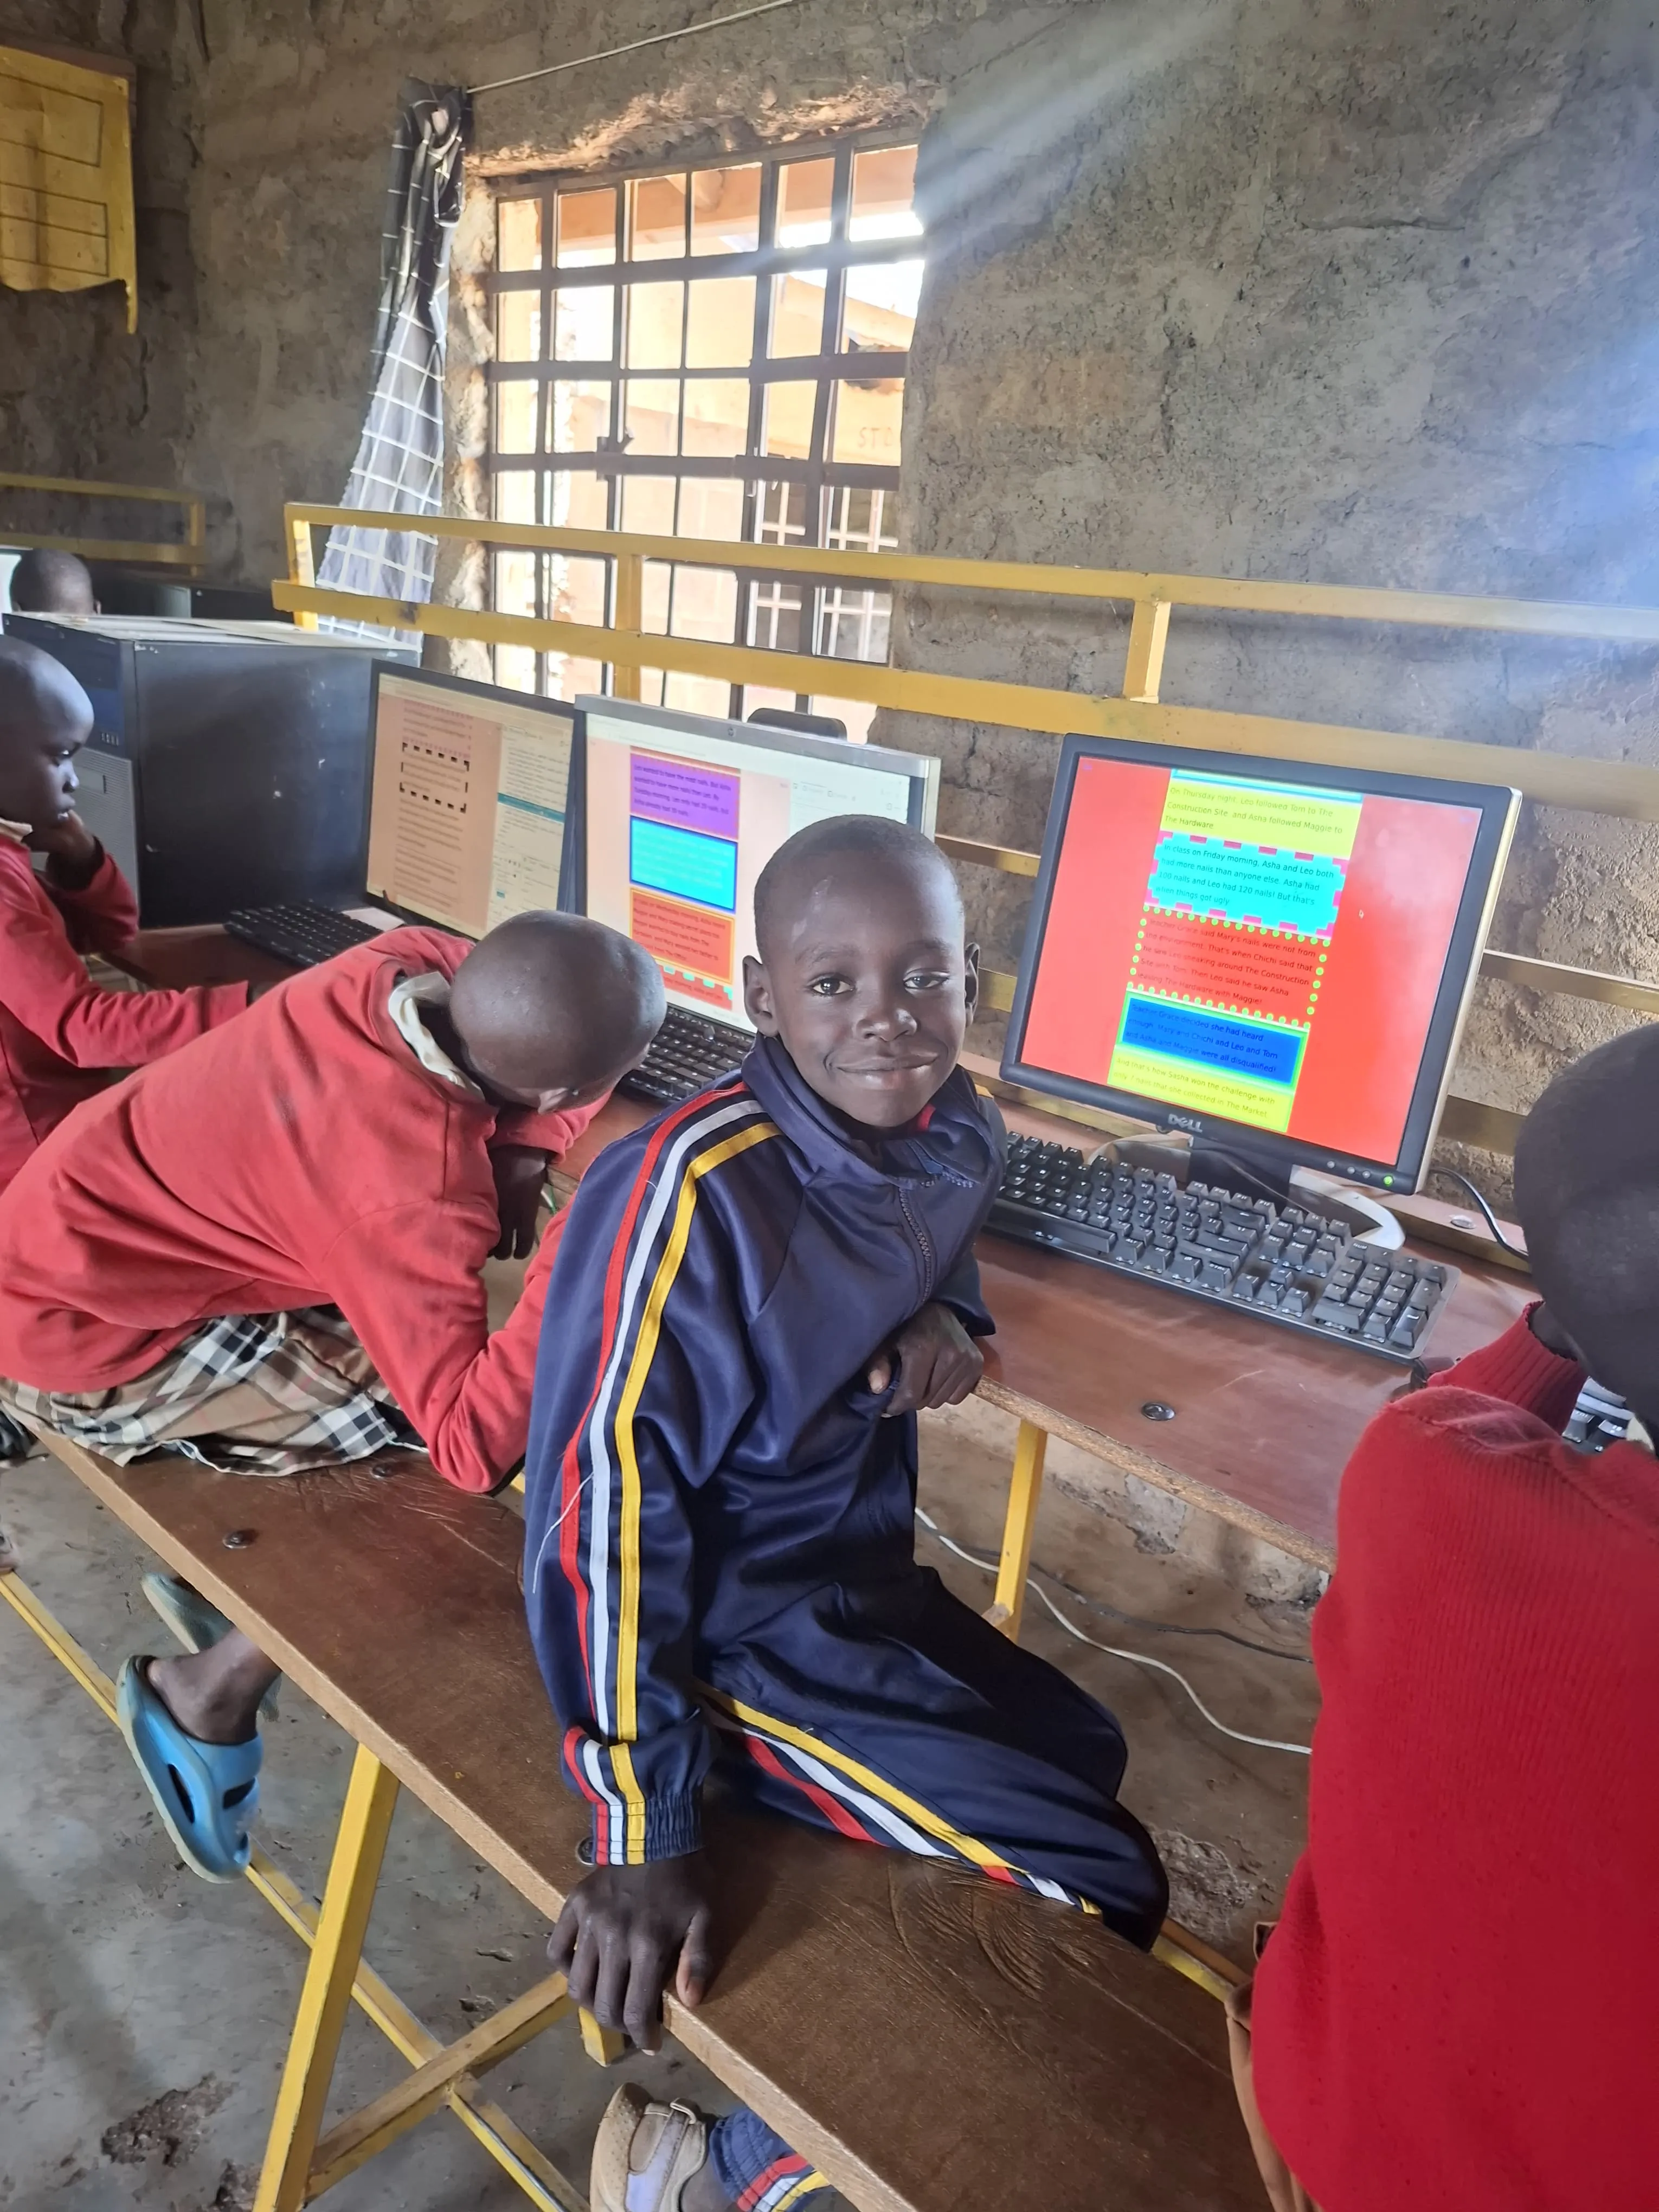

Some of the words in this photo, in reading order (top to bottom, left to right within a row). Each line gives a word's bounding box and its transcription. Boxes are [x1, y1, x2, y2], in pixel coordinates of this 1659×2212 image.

[1182, 789, 1216, 801] Thursday
[1240, 796, 1255, 805] Leo
[1255, 799, 1288, 810] followed
[1289, 803, 1306, 813] Tom
[1307, 806, 1317, 814] to
[1318, 807, 1334, 816] The
[1164, 815, 1178, 824] The
[1166, 801, 1212, 815] Construction
[1231, 811, 1247, 820] and
[1248, 813, 1268, 822] Asha
[1268, 816, 1302, 828] followed
[1302, 821, 1333, 834] Maggie
[1334, 825, 1343, 834] to
[1160, 857, 1175, 866] had
[1175, 861, 1195, 870] more
[1196, 863, 1214, 873] nails
[1214, 866, 1232, 876] than
[1233, 871, 1262, 883] anyone
[1282, 878, 1303, 888] Asha
[1304, 882, 1320, 891] had
[1163, 844, 1172, 852] In
[1172, 845, 1191, 855] class
[1202, 850, 1225, 862] Friday
[1226, 854, 1261, 868] morning,
[1261, 859, 1281, 870] Asha
[1282, 863, 1298, 872] and
[1299, 866, 1314, 875] Leo
[1315, 869, 1335, 879] both
[1158, 871, 1172, 880] 100
[1173, 873, 1191, 883] nails
[1191, 877, 1206, 886] and
[1207, 879, 1221, 889] Leo
[1222, 882, 1237, 891] had
[1238, 885, 1253, 894] 120
[1253, 888, 1276, 898] nails!
[1277, 892, 1291, 901] But
[1292, 894, 1315, 905] that's
[1175, 889, 1198, 901] things
[1199, 893, 1212, 903] got
[1199, 928, 1215, 938] said
[1216, 931, 1241, 944] Mary's
[1242, 936, 1261, 947] nails
[1261, 942, 1281, 950] were
[1282, 944, 1296, 954] not
[1297, 947, 1316, 957] from
[1142, 945, 1152, 953] he
[1216, 960, 1243, 972] around
[1244, 966, 1259, 975] The
[1260, 969, 1310, 986] Construction
[1231, 949, 1252, 959] when
[1253, 953, 1277, 964] Chichi
[1278, 958, 1295, 968] said
[1296, 962, 1314, 972] that
[1190, 969, 1208, 979] Then
[1210, 973, 1223, 982] Leo
[1224, 976, 1240, 986] said
[1241, 980, 1252, 988] he
[1252, 983, 1269, 992] saw
[1269, 986, 1290, 996] Asha
[1214, 988, 1231, 999] with
[1232, 992, 1263, 1007] Maggie!
[1210, 1023, 1224, 1032] she
[1225, 1026, 1240, 1036] had
[1241, 1030, 1264, 1041] heard
[1214, 1038, 1230, 1047] and
[1230, 1041, 1245, 1051] Leo
[1245, 1045, 1261, 1055] and
[1262, 1049, 1278, 1059] Tom
[1200, 1050, 1218, 1059] were
[1219, 1053, 1230, 1062] all
[1230, 1056, 1276, 1075] disqualified!
[1151, 1066, 1167, 1077] how
[1167, 1071, 1189, 1083] Sasha
[1190, 1078, 1206, 1086] won
[1206, 1081, 1220, 1090] the
[1220, 1084, 1258, 1102] challenge
[1258, 1094, 1276, 1105] with
[1152, 1081, 1167, 1090] that
[1168, 1085, 1182, 1095] she
[1183, 1089, 1216, 1103] collected
[1226, 1100, 1240, 1110] The
[1168, 1114, 1203, 1133] DELL
